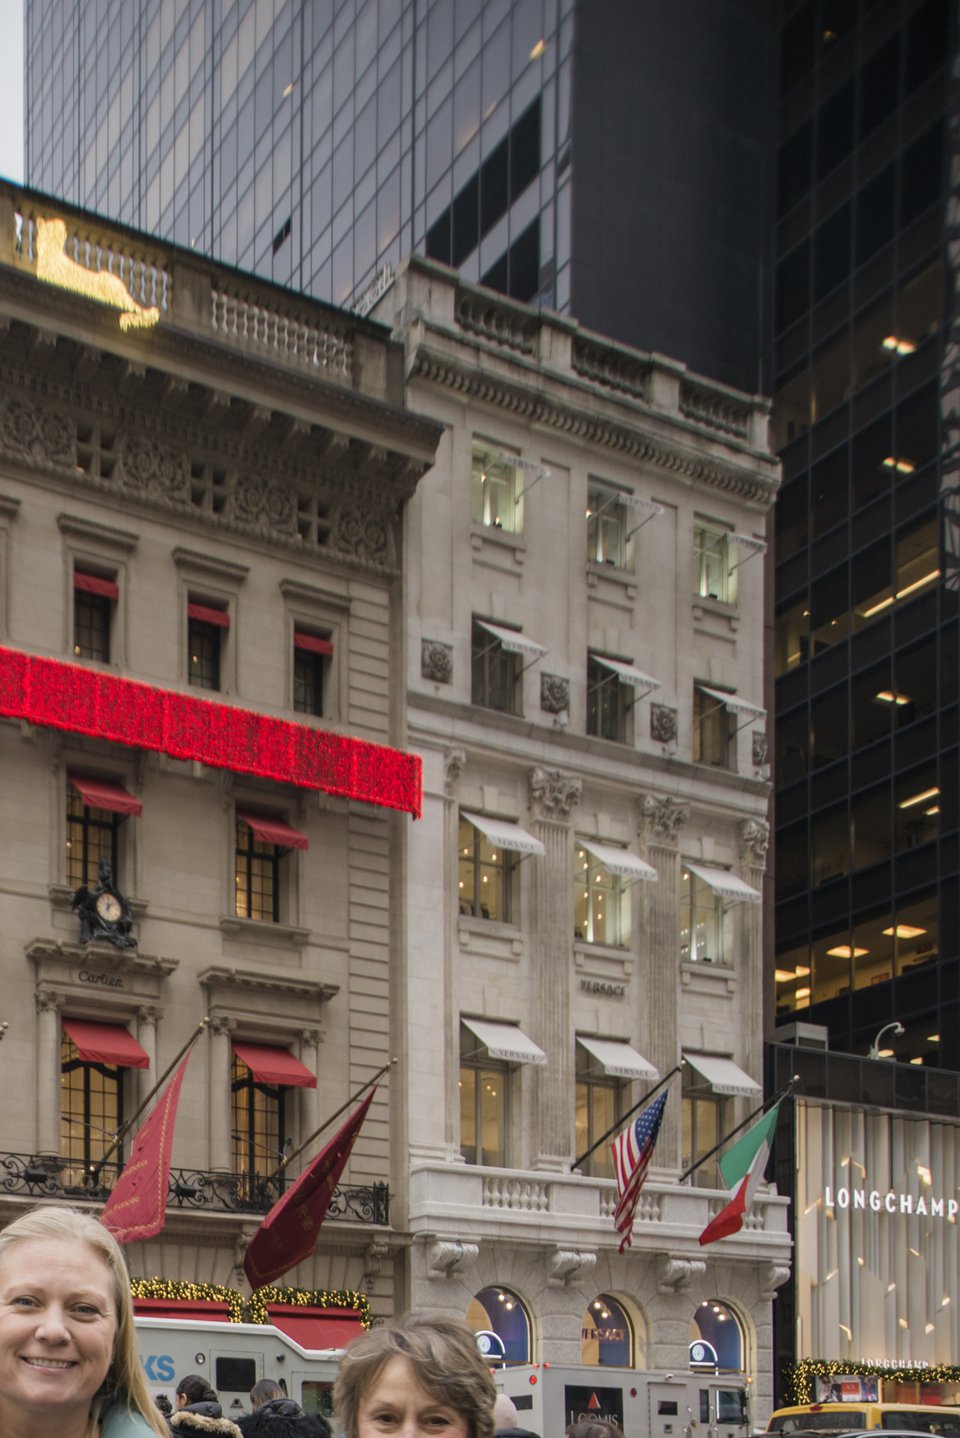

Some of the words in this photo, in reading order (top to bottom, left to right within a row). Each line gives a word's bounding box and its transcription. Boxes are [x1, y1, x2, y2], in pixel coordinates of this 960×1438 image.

[497, 837, 535, 850] VERSACE
[613, 866, 649, 878] VERSACE
[78, 970, 124, 988] Cartier
[580, 979, 626, 997] VERSACE
[498, 1048, 535, 1061] VERSACE
[825, 1186, 959, 1218] LONGCHAMP
